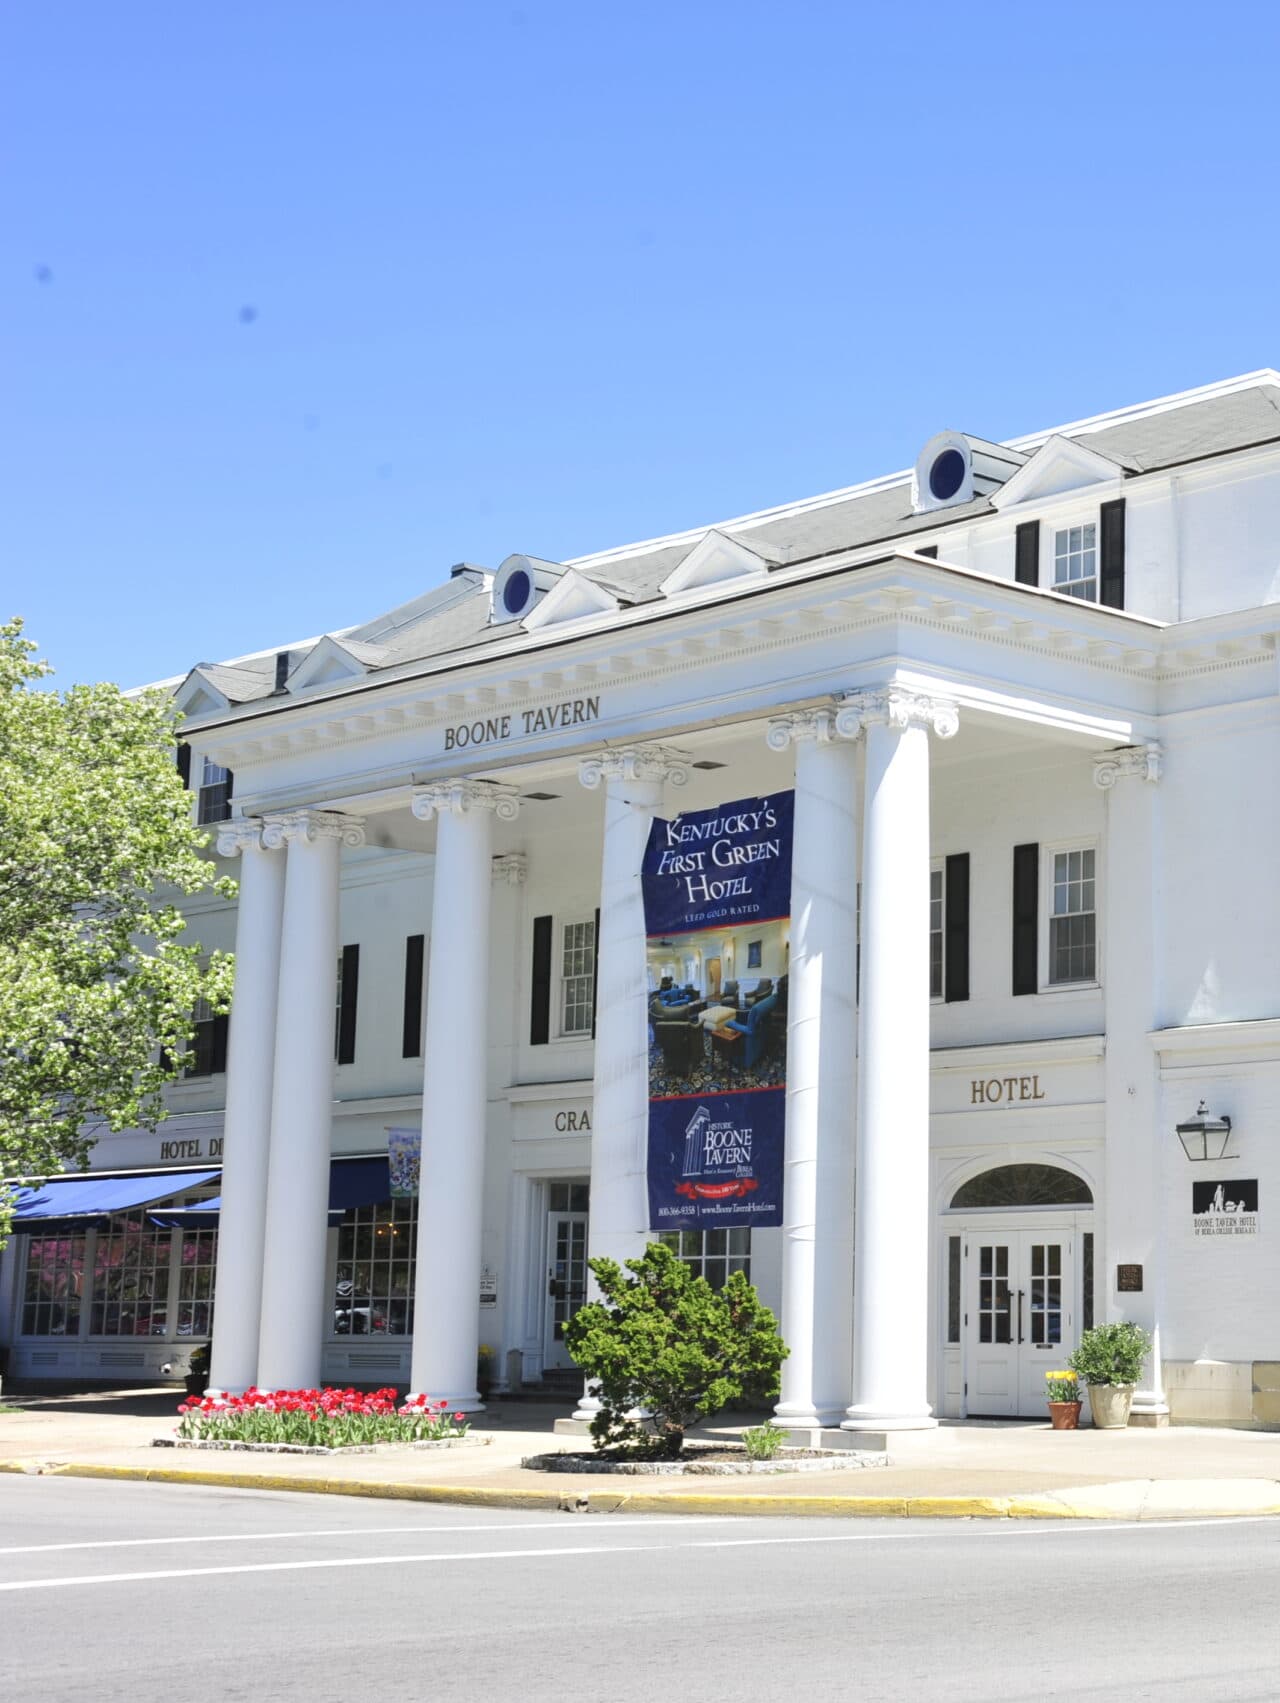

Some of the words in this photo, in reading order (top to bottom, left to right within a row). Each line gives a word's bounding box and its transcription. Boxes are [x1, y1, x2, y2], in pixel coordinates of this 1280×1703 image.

[444, 715, 511, 750] BOONE
[522, 696, 600, 733] TAVERN
[666, 800, 777, 846] KENTUCKY'S
[656, 850, 706, 875] FIRST
[712, 839, 781, 867] GREEN
[684, 874, 753, 903] HOTEL
[971, 1075, 1045, 1103] HOTEL
[160, 1139, 203, 1160] HOTEL
[208, 1138, 225, 1156] DI
[705, 1128, 752, 1149] BOONE
[703, 1146, 752, 1165] TAVERN
[1216, 1217, 1237, 1227] TAVERN
[1239, 1217, 1256, 1226] HOTEL
